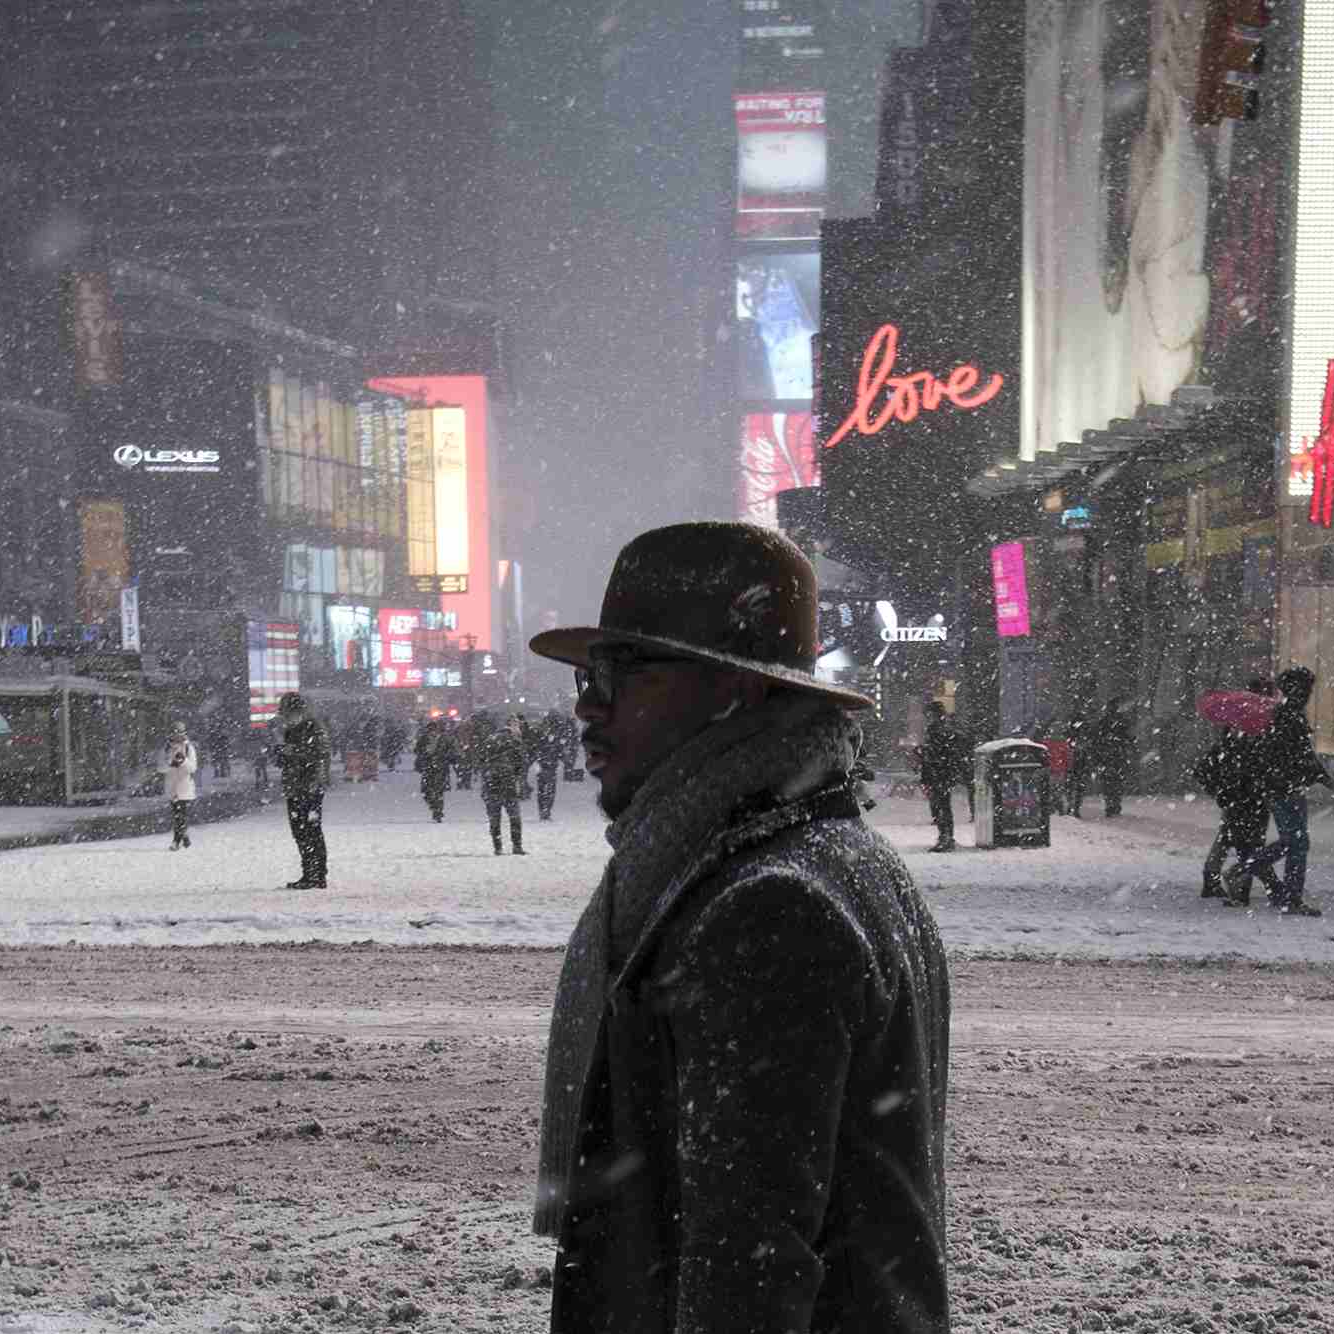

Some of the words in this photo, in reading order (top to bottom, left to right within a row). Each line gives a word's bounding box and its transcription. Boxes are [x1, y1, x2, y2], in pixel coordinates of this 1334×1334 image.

[823, 323, 1004, 448] love
[144, 450, 220, 463] LEXUS
[880, 626, 948, 642] CITIZEN
